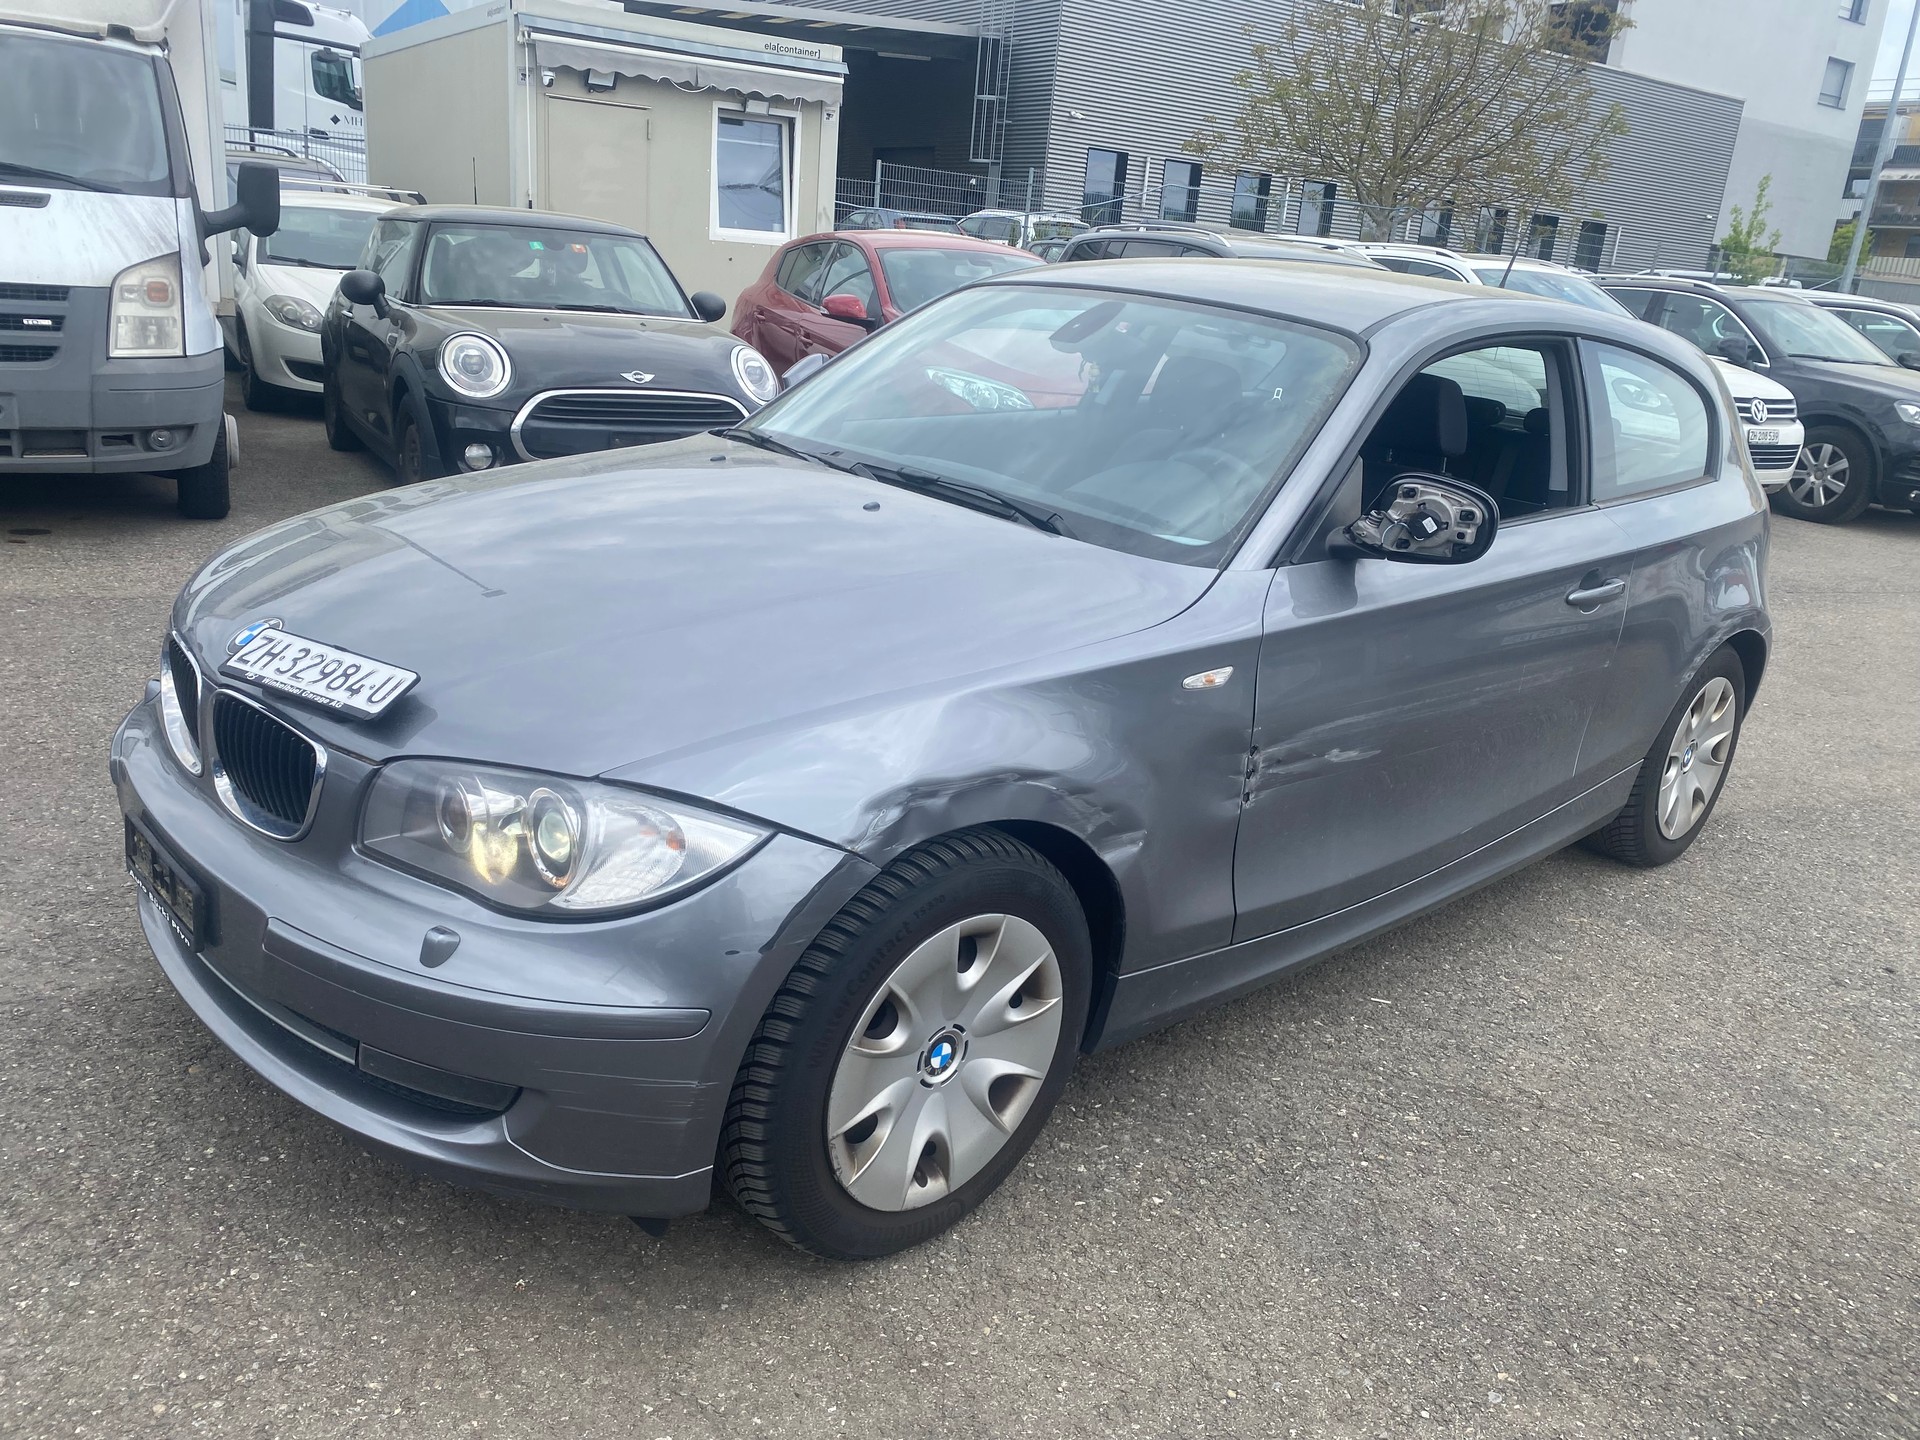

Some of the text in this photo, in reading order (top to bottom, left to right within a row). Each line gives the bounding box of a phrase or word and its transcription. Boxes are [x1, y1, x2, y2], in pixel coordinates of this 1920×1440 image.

[764, 42, 821, 59] ela[container]
[301, 688, 331, 705] Garage
[329, 699, 344, 709] AG
[129, 869, 147, 893] Auto
